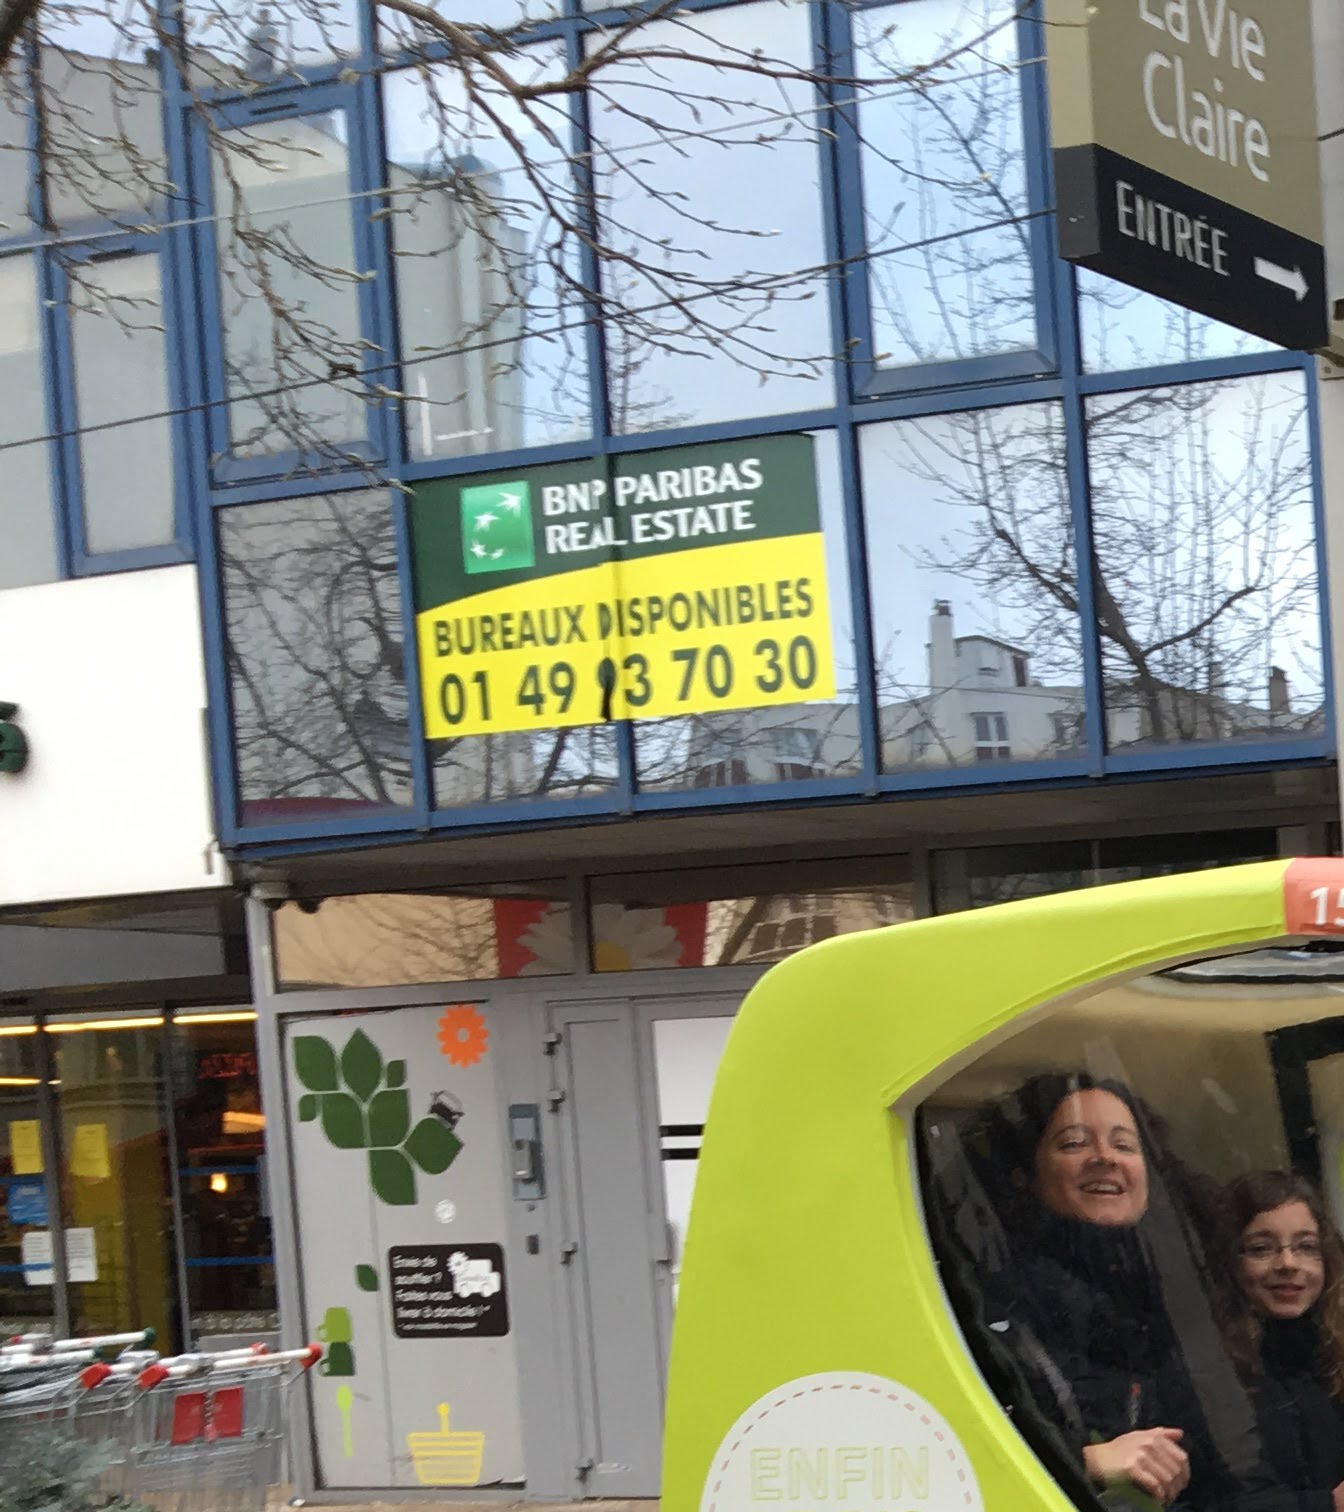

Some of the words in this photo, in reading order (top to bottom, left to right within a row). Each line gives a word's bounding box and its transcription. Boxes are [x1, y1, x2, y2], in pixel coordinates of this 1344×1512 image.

[1137, 0, 1190, 43] a
[1197, 0, 1266, 82] Vie
[1143, 52, 1270, 182] Claire
[1116, 180, 1231, 277] ENTRÉE
[542, 479, 606, 515] BNP
[614, 459, 763, 506] PARIBAS
[545, 517, 628, 553] REAL
[631, 500, 756, 543] ESTATE
[434, 604, 587, 657] BUREAUX
[597, 578, 813, 640] DISPONIBLES
[440, 671, 491, 725] 01
[517, 661, 576, 715] 49
[598, 653, 652, 716] 93
[672, 644, 734, 701] 70
[754, 635, 818, 693] 30
[750, 1446, 930, 1501] ENFIN
